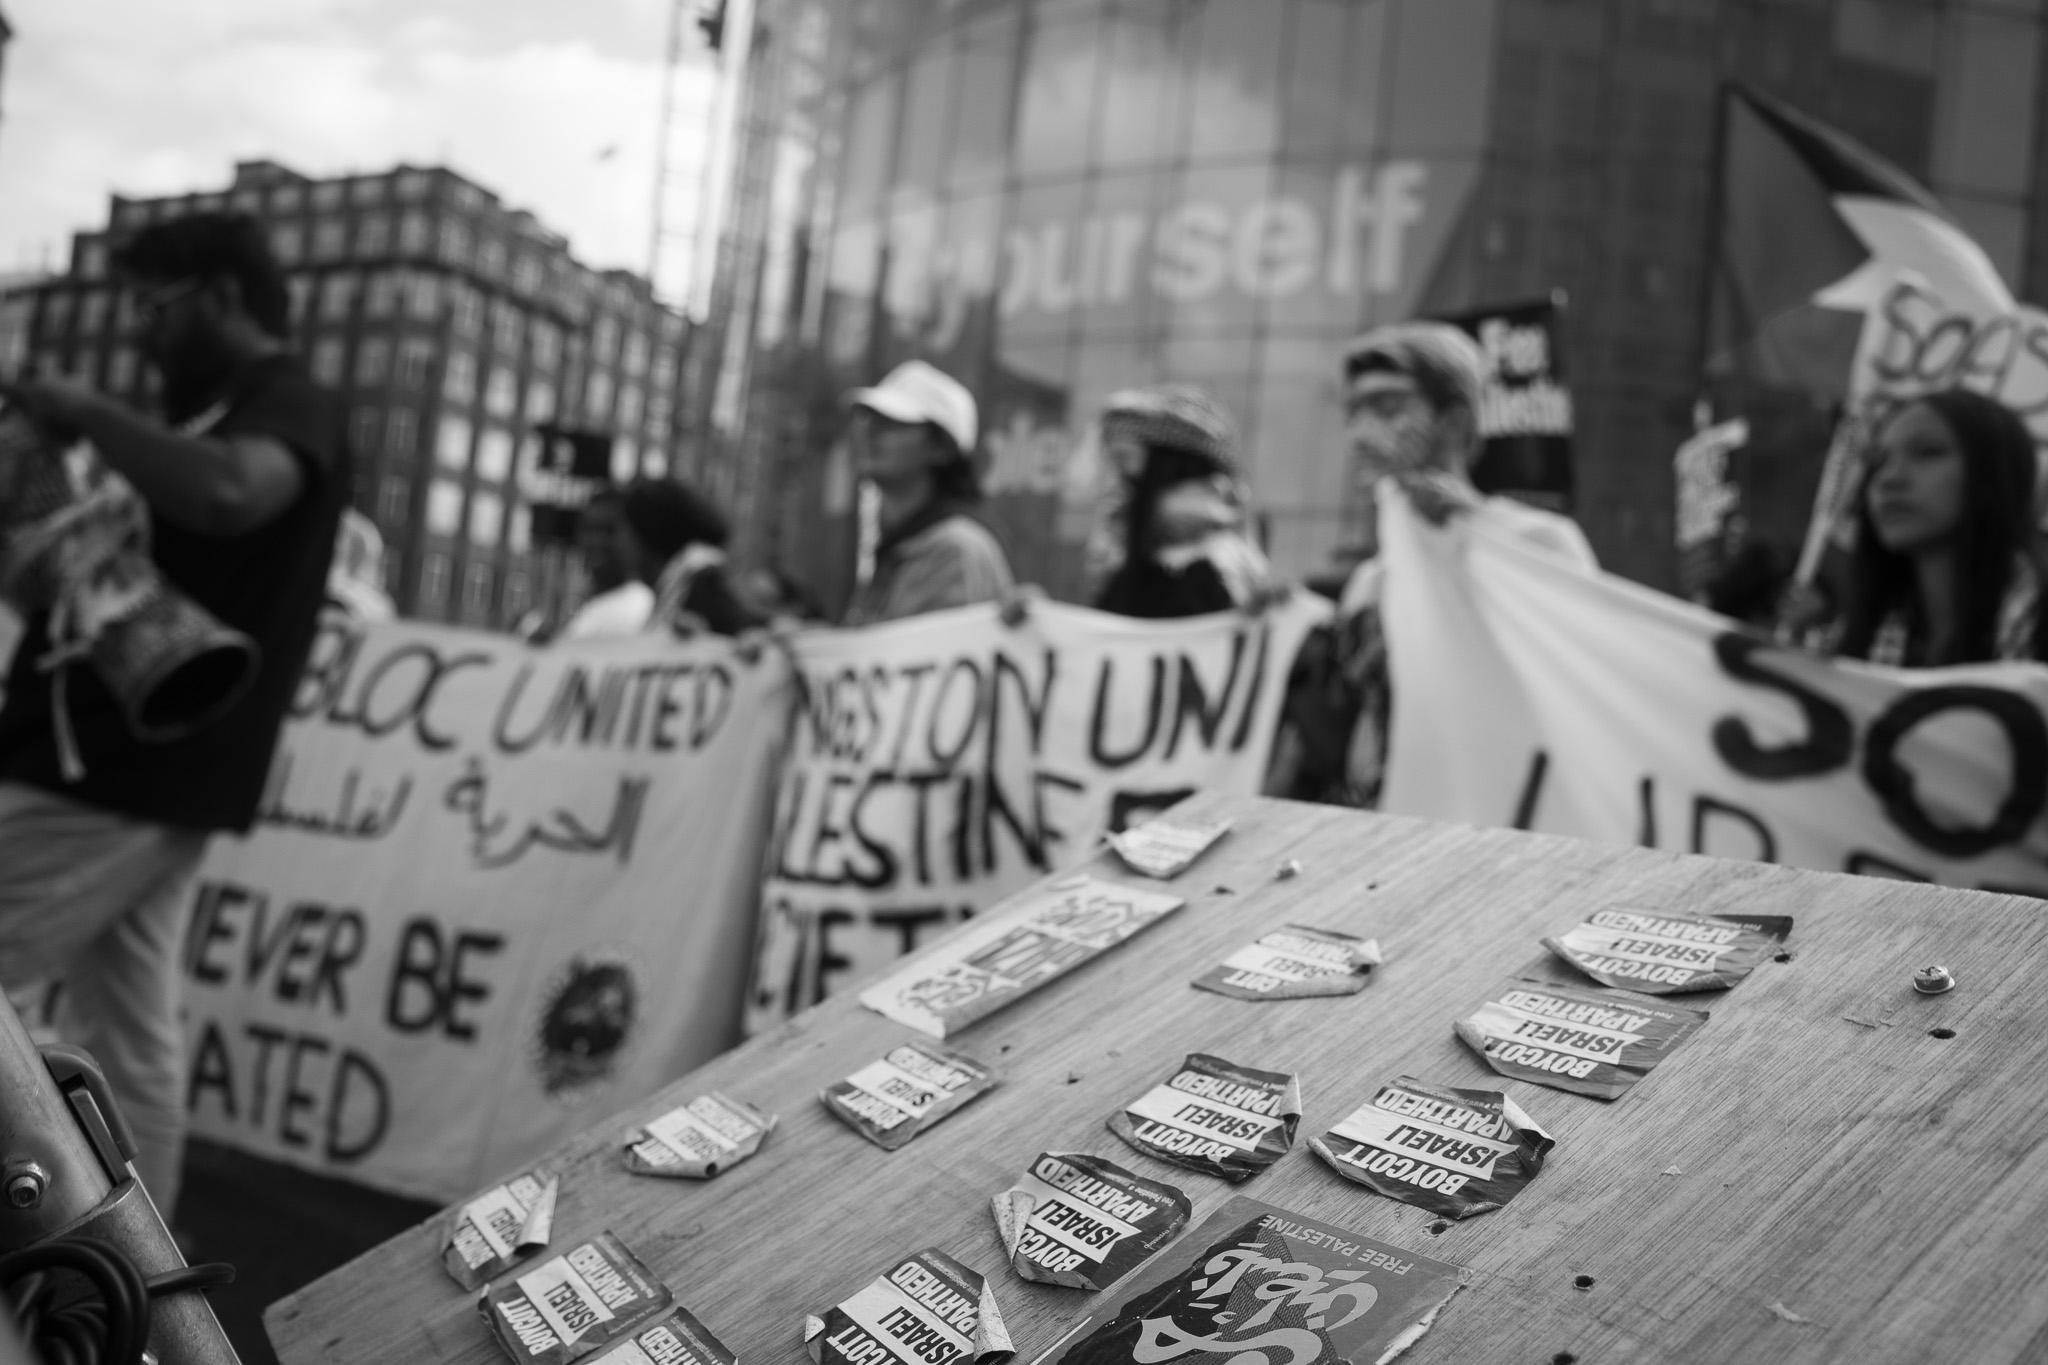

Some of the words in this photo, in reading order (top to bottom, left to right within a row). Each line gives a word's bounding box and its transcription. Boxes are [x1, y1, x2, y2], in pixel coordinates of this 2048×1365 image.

[493, 660, 735, 755] UNITED
[1090, 622, 1268, 769] UNI
[775, 770, 1085, 890] LESTINE
[1591, 910, 1742, 943] APARTHEID
[1611, 937, 1718, 964] ISRAELI
[186, 882, 368, 1015] EVER
[386, 916, 505, 1045] BE
[1499, 990, 1653, 1033] APARTHEID
[1513, 1020, 1629, 1055] ISRAELI
[186, 1018, 391, 1165] ATED
[1374, 1088, 1514, 1142] APARTHEID
[1172, 1103, 1268, 1141] ISRAELI
[1384, 1124, 1500, 1169] ISRAELI
[1035, 1157, 1158, 1224] APARTHEID
[1336, 1143, 1471, 1197] BOYCOTT
[1032, 1198, 1122, 1250] ISRAELI
[1257, 1213, 1362, 1257] PALESTINE
[1358, 1247, 1416, 1276] FREE
[496, 1296, 560, 1356] BOYCOTT
[543, 1280, 600, 1334] ISRAELI
[890, 1261, 979, 1340] PARTHEID
[876, 1305, 963, 1365] ISRAELI
